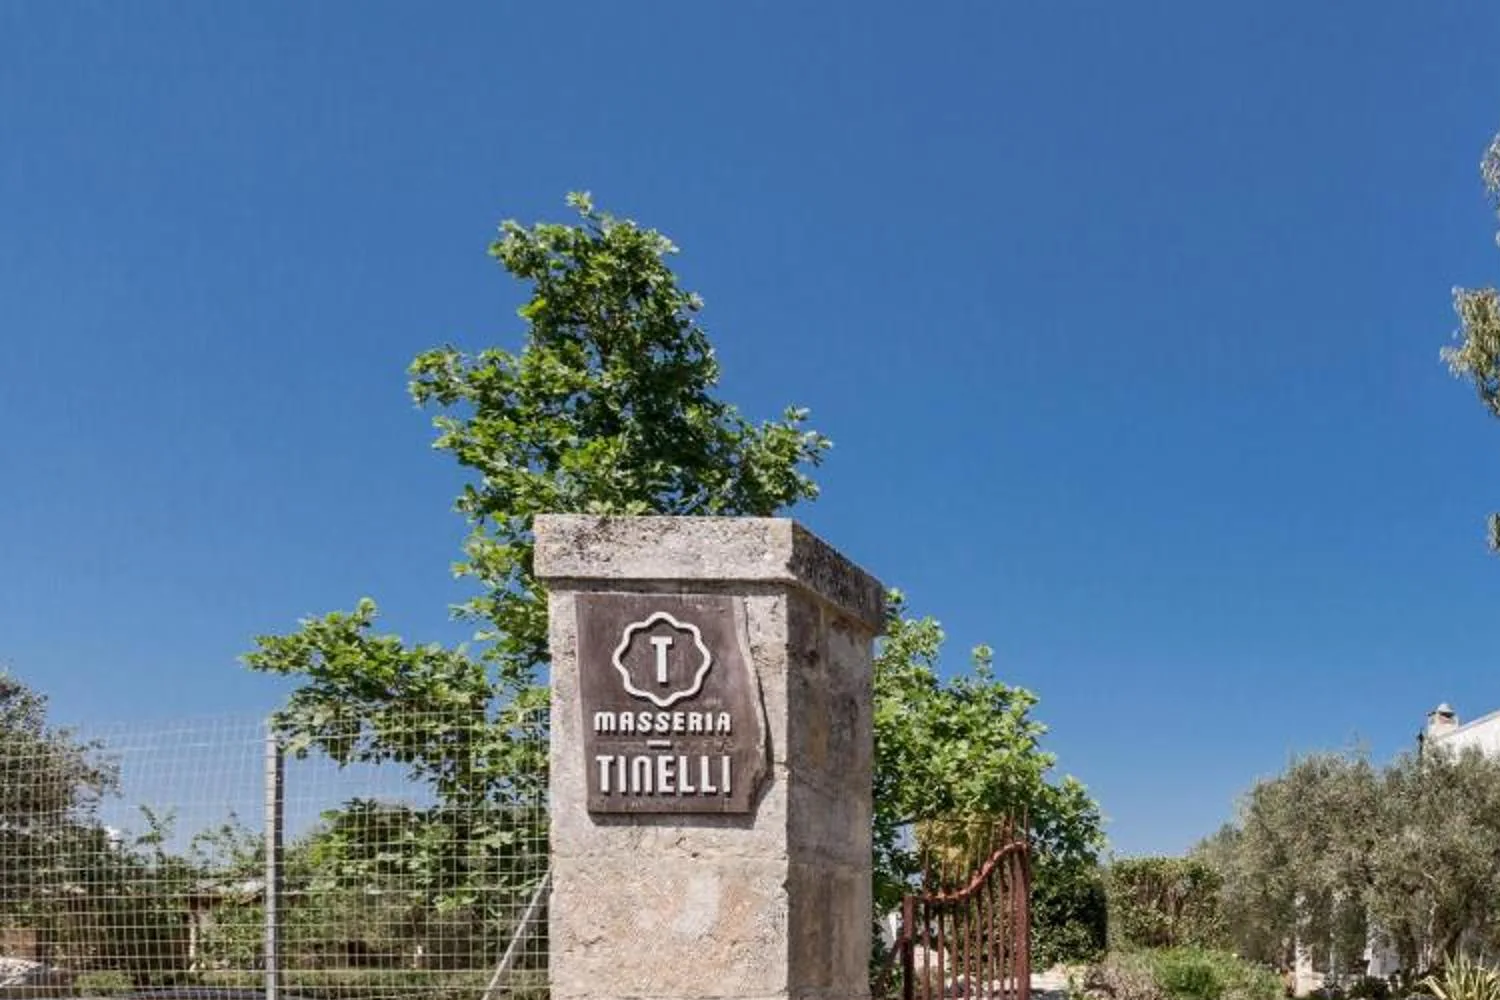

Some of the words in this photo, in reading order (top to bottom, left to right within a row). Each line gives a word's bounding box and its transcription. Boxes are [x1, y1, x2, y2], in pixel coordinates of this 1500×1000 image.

[650, 636, 673, 683] T
[594, 711, 732, 732] MASSERIA
[596, 755, 732, 793] TINELLI
